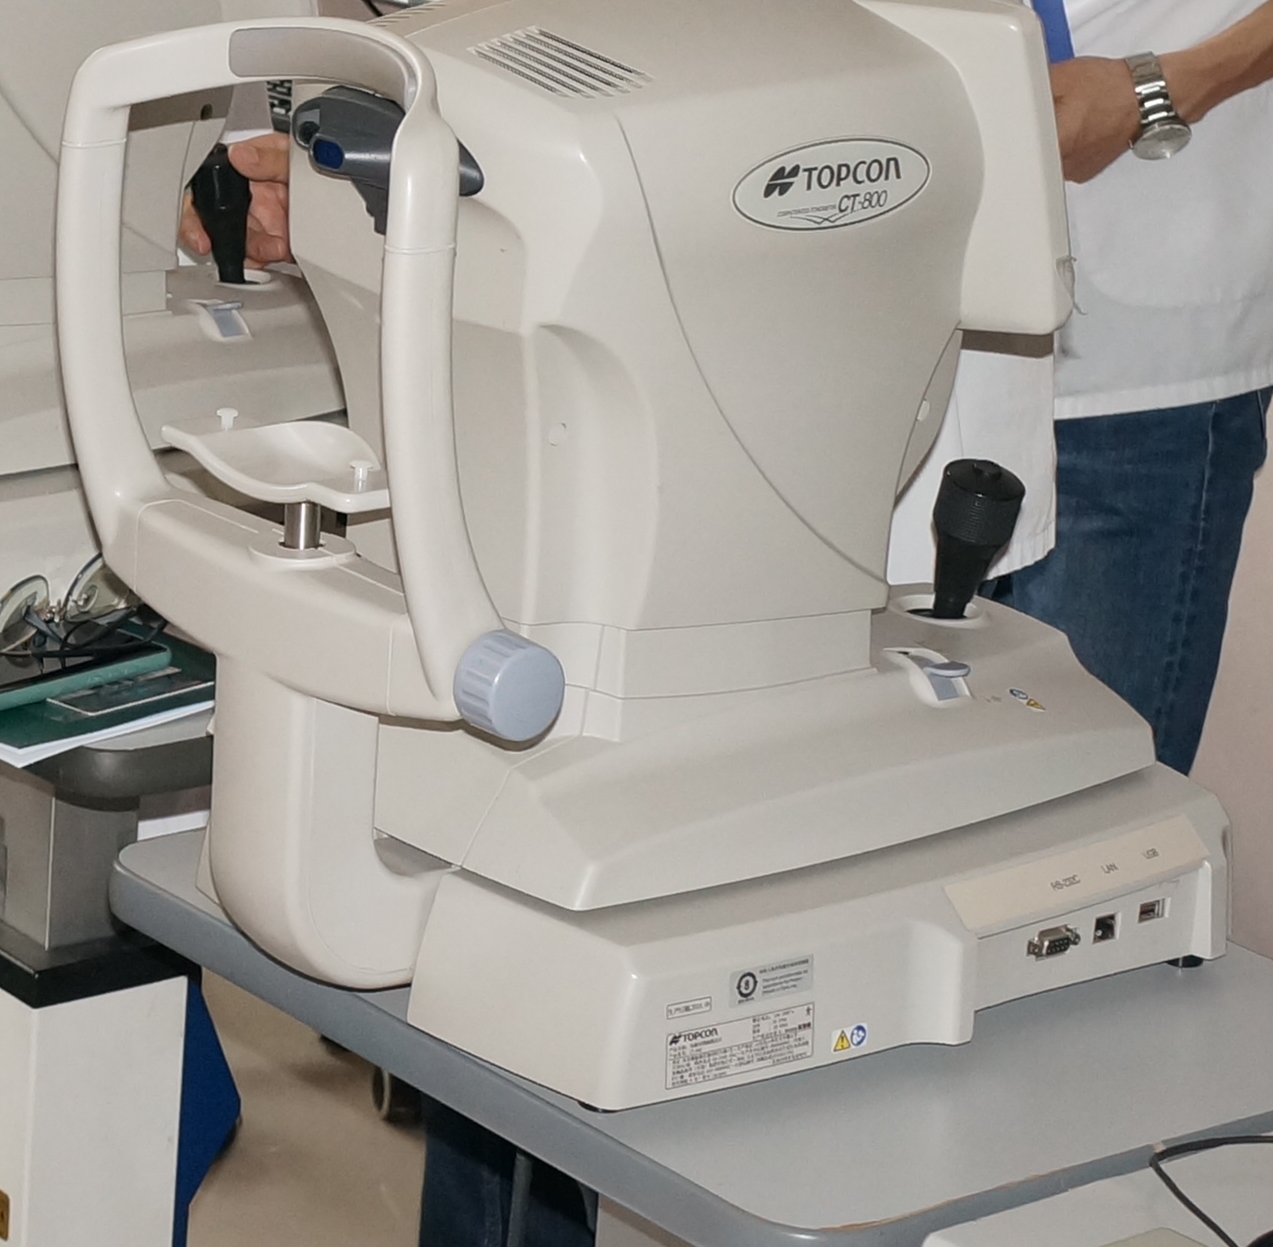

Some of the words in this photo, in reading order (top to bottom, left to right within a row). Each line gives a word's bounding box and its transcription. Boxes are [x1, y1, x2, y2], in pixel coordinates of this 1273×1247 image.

[802, 157, 902, 191] TOPCON
[837, 190, 888, 214] CT-800
[683, 1028, 718, 1043] TOPCON
